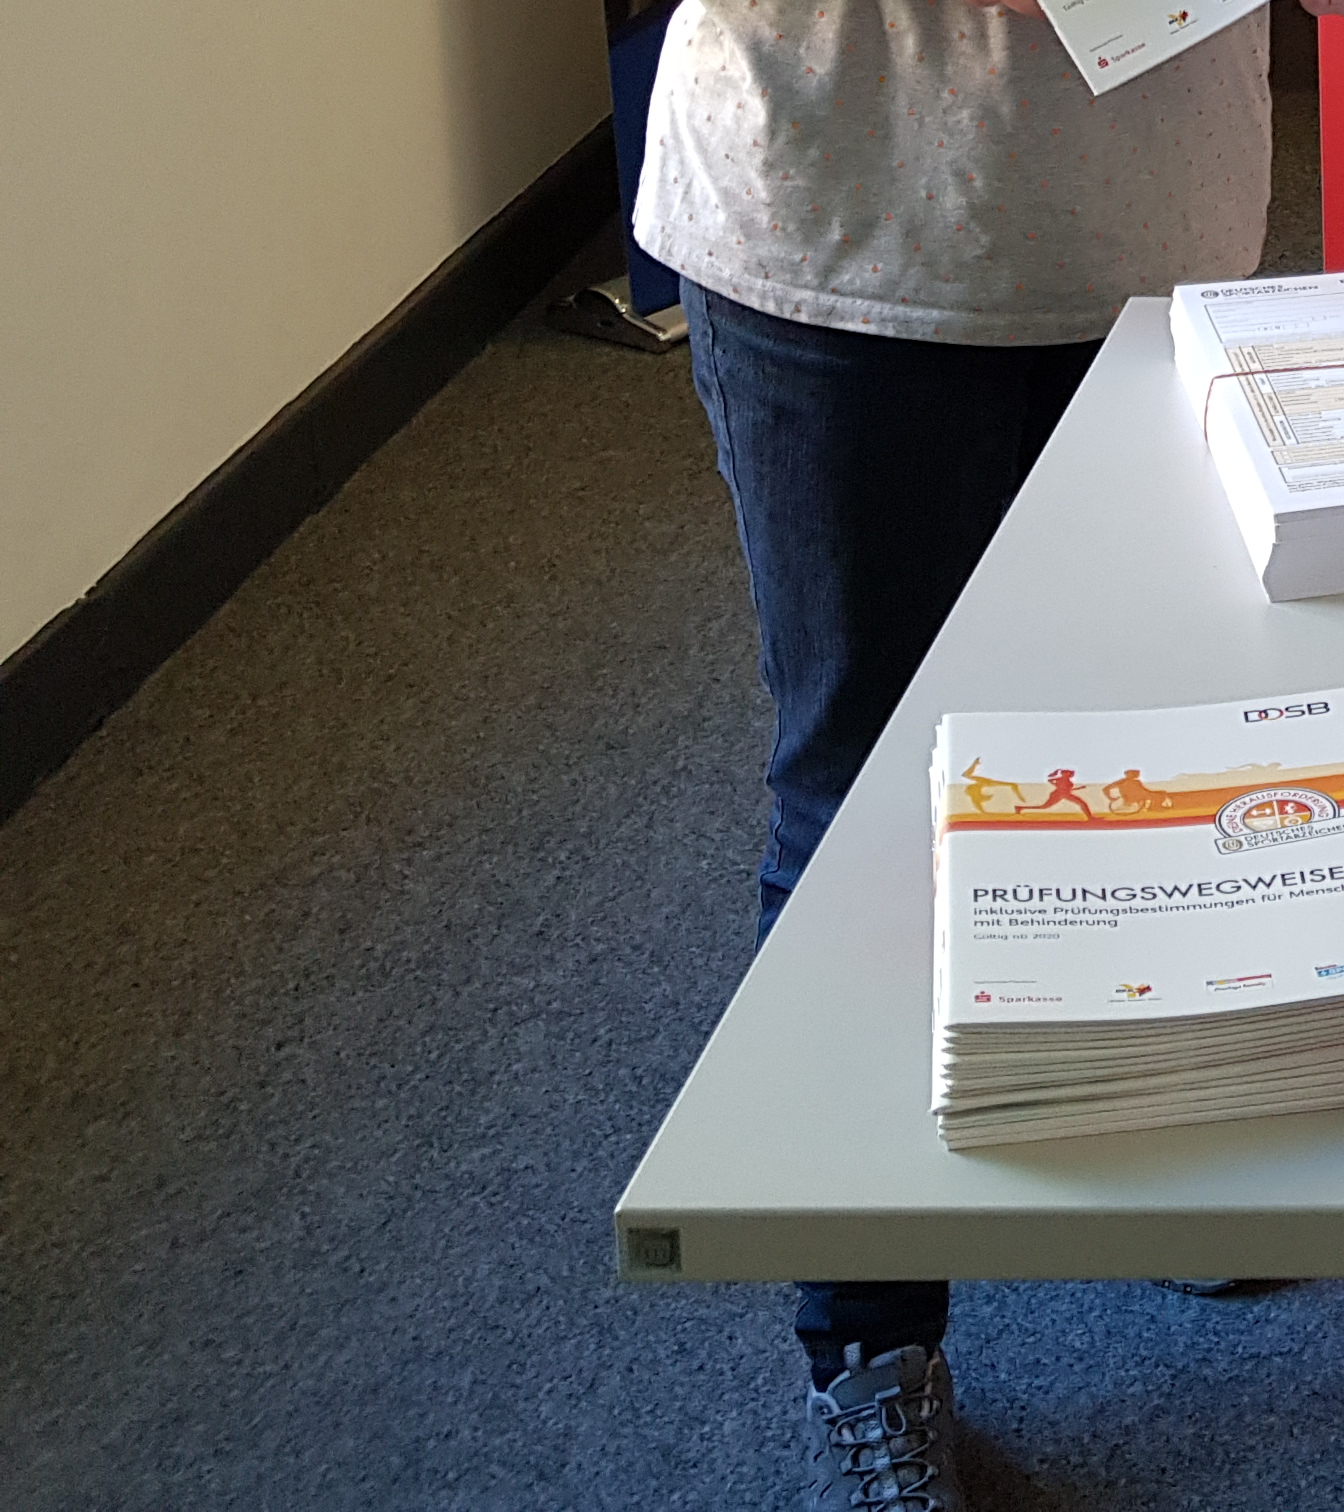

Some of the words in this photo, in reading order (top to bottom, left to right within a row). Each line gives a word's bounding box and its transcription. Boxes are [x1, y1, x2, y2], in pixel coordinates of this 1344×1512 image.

[1243, 700, 1331, 724] DOSB
[973, 906, 1048, 917] inklusive
[1052, 896, 1256, 918] Prüfungsbestimmungen
[1260, 892, 1285, 904] für
[973, 917, 1003, 928] mit
[1008, 916, 1119, 929] Behinderung
[998, 995, 1064, 1004] Sparkasse
